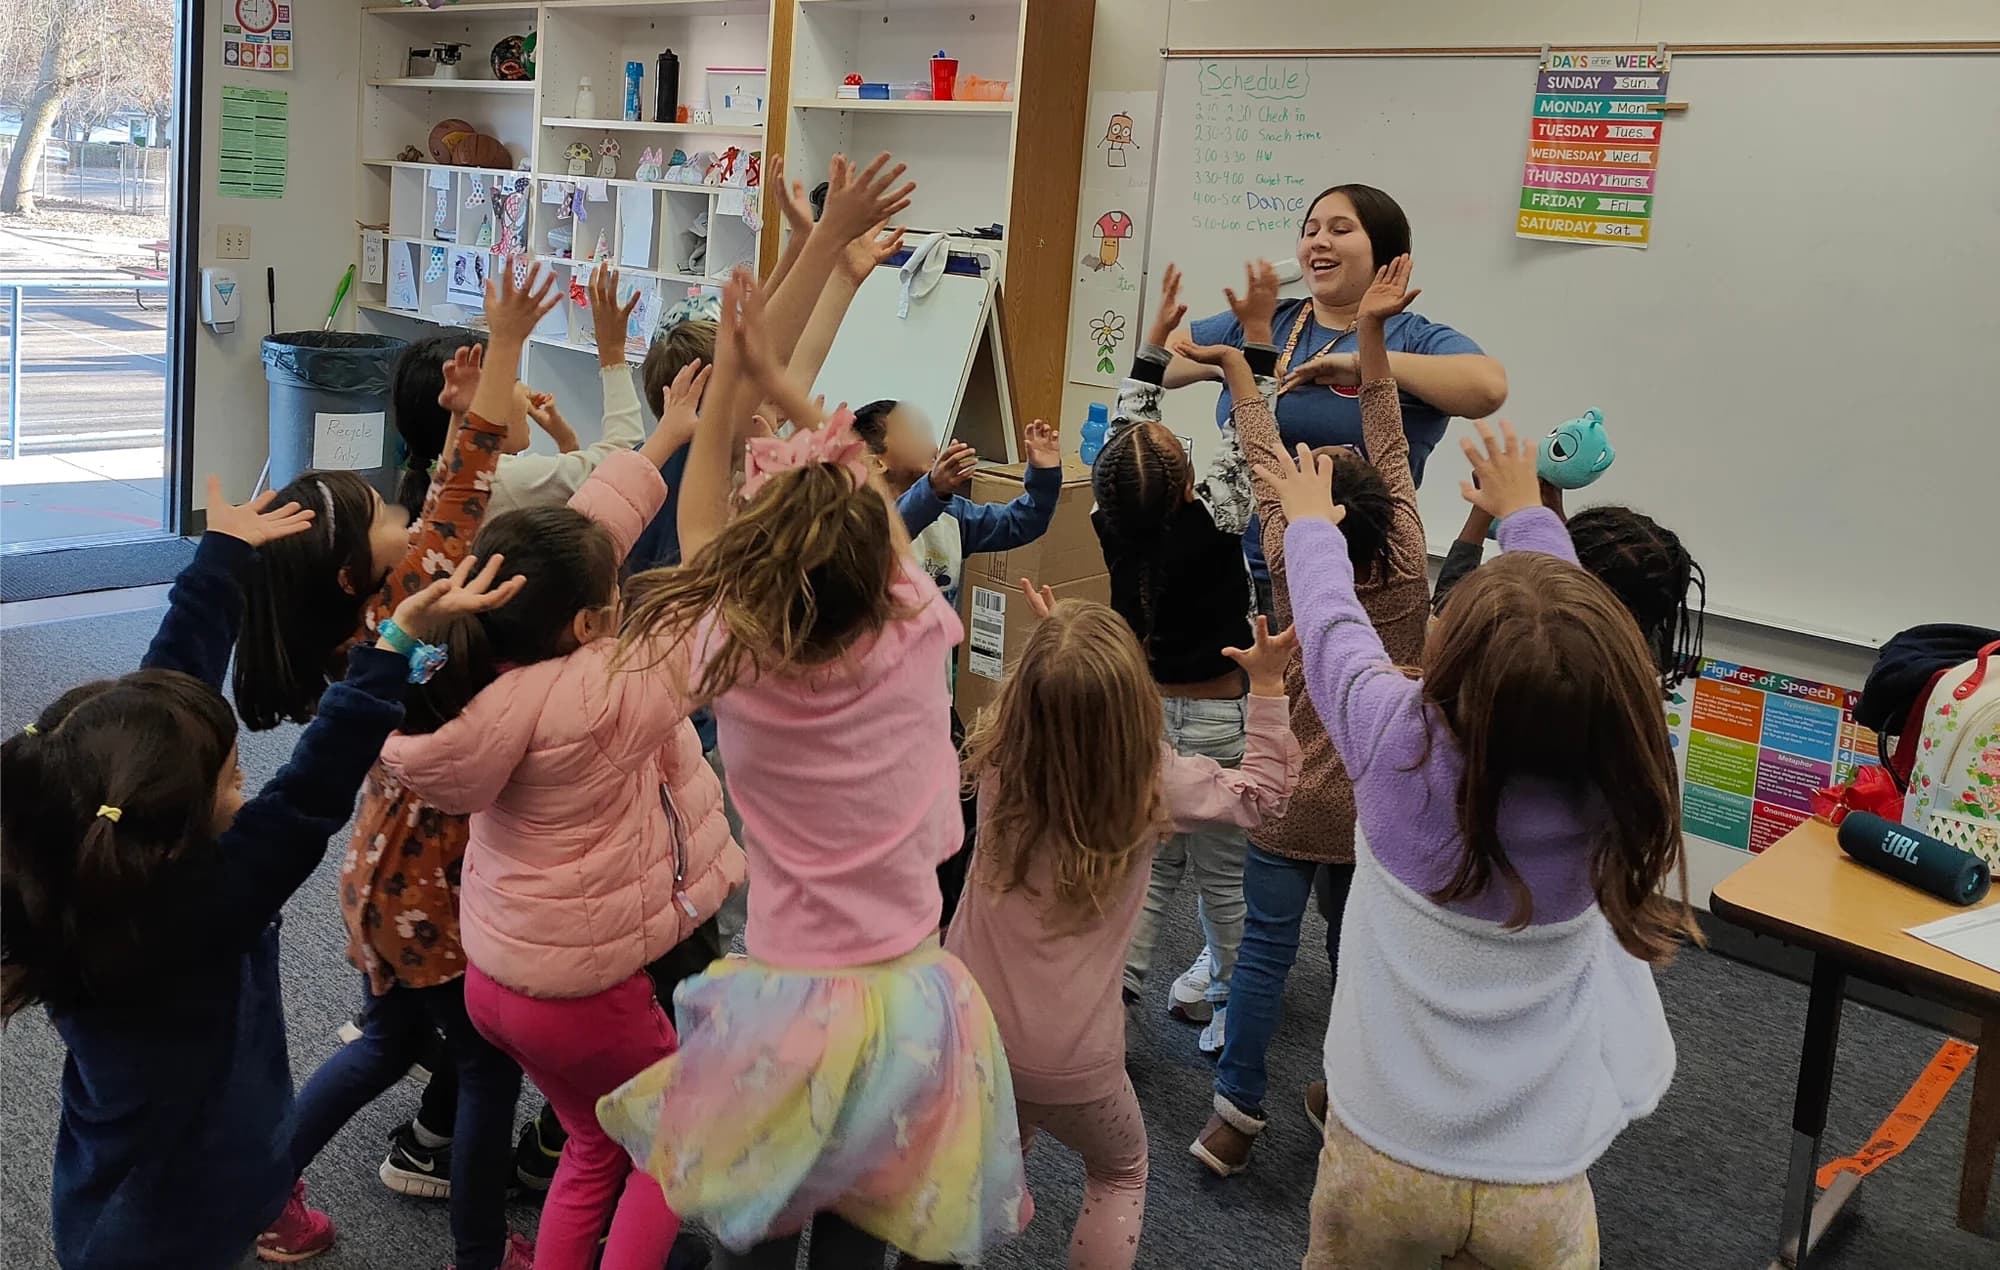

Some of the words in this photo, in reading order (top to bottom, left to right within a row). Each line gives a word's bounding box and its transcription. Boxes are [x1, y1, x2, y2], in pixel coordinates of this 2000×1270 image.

[1552, 55, 1588, 68] DAYS
[1615, 55, 1657, 69] WEEK
[1207, 63, 1299, 91] Schedule
[1547, 76, 1602, 90] SUNDAY
[1621, 77, 1650, 89] Sun.
[1540, 100, 1602, 114] MONDAY
[1538, 123, 1600, 138] TUESDAY
[1615, 126, 1646, 138] Tues.
[1531, 147, 1602, 161] WEDNESDAY
[1528, 168, 1600, 186] THURSDAY
[1604, 174, 1645, 187] Thurs.
[1246, 191, 1305, 212] Dance
[1531, 193, 1586, 209] FRIDAY
[1610, 199, 1632, 212] Fri.
[1520, 215, 1593, 233] SATURDAY
[326, 419, 372, 440] Recycle
[1703, 661, 1756, 684] Figures
[1759, 675, 1776, 688] of
[1780, 679, 1836, 701] Speech
[1842, 738, 1851, 748] 3
[1777, 753, 1814, 770] Metaphor
[1840, 751, 1849, 761] 4
[1839, 764, 1848, 774] 5
[1763, 806, 1806, 823] Onomatop
[1881, 830, 1920, 865] JBL
